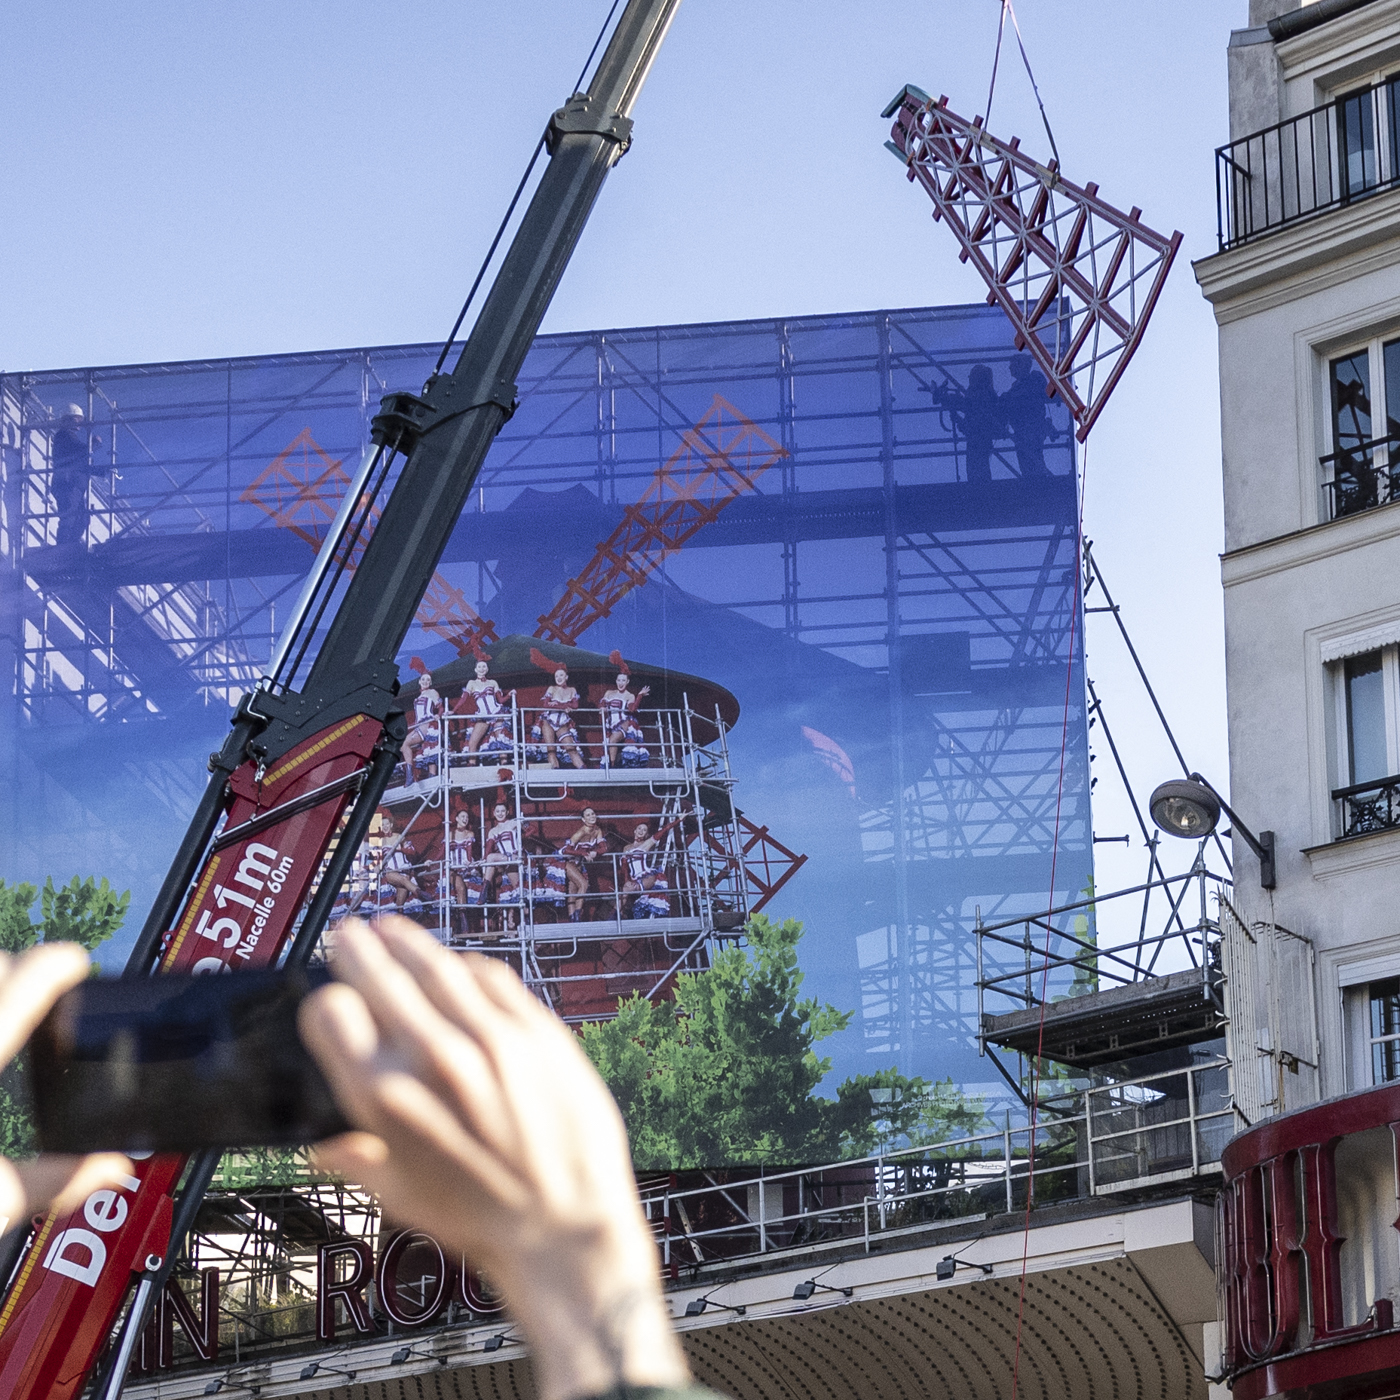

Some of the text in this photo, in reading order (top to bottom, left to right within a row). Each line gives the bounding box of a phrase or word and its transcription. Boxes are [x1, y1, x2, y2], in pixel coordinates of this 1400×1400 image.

[195, 842, 278, 949] 51m
[235, 855, 294, 960] Nacelle 60m
[316, 1227, 510, 1343] ROU
